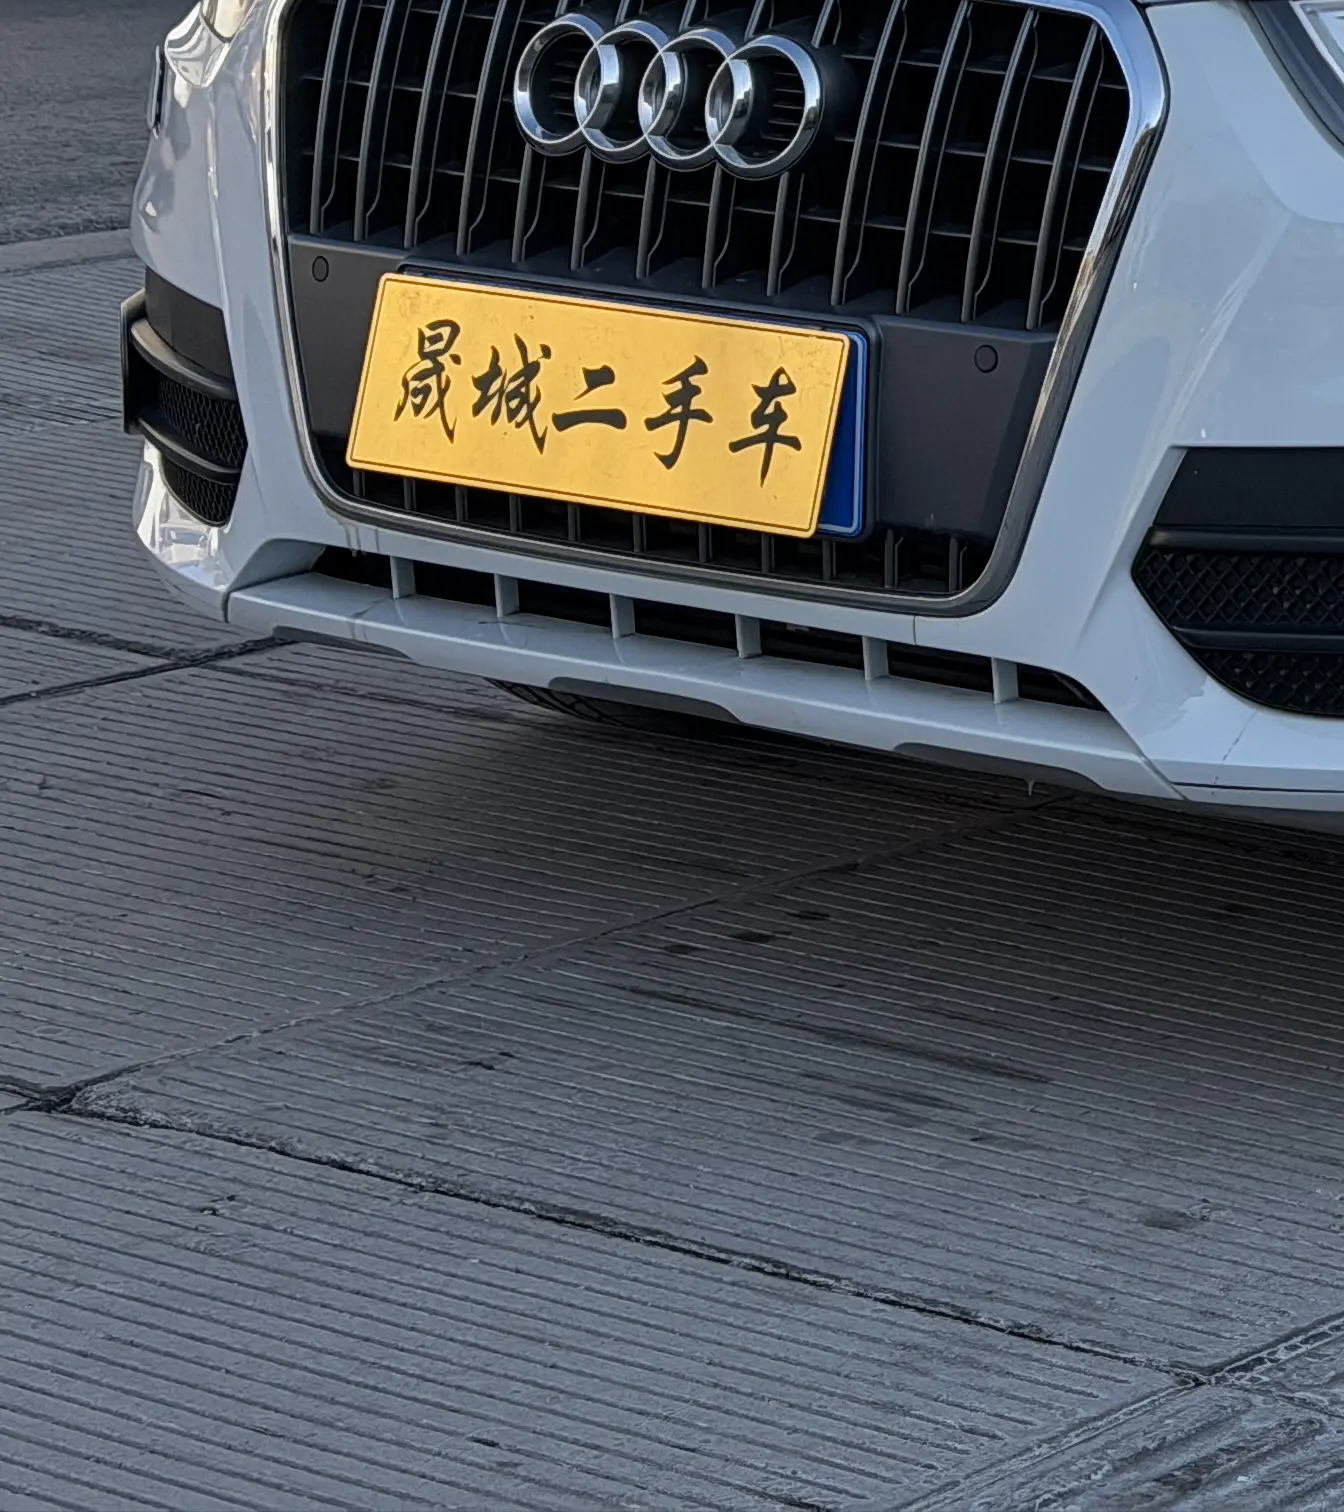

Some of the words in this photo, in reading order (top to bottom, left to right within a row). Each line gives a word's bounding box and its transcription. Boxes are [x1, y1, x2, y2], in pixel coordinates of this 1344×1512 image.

[394, 319, 802, 487] 晟城二手车
